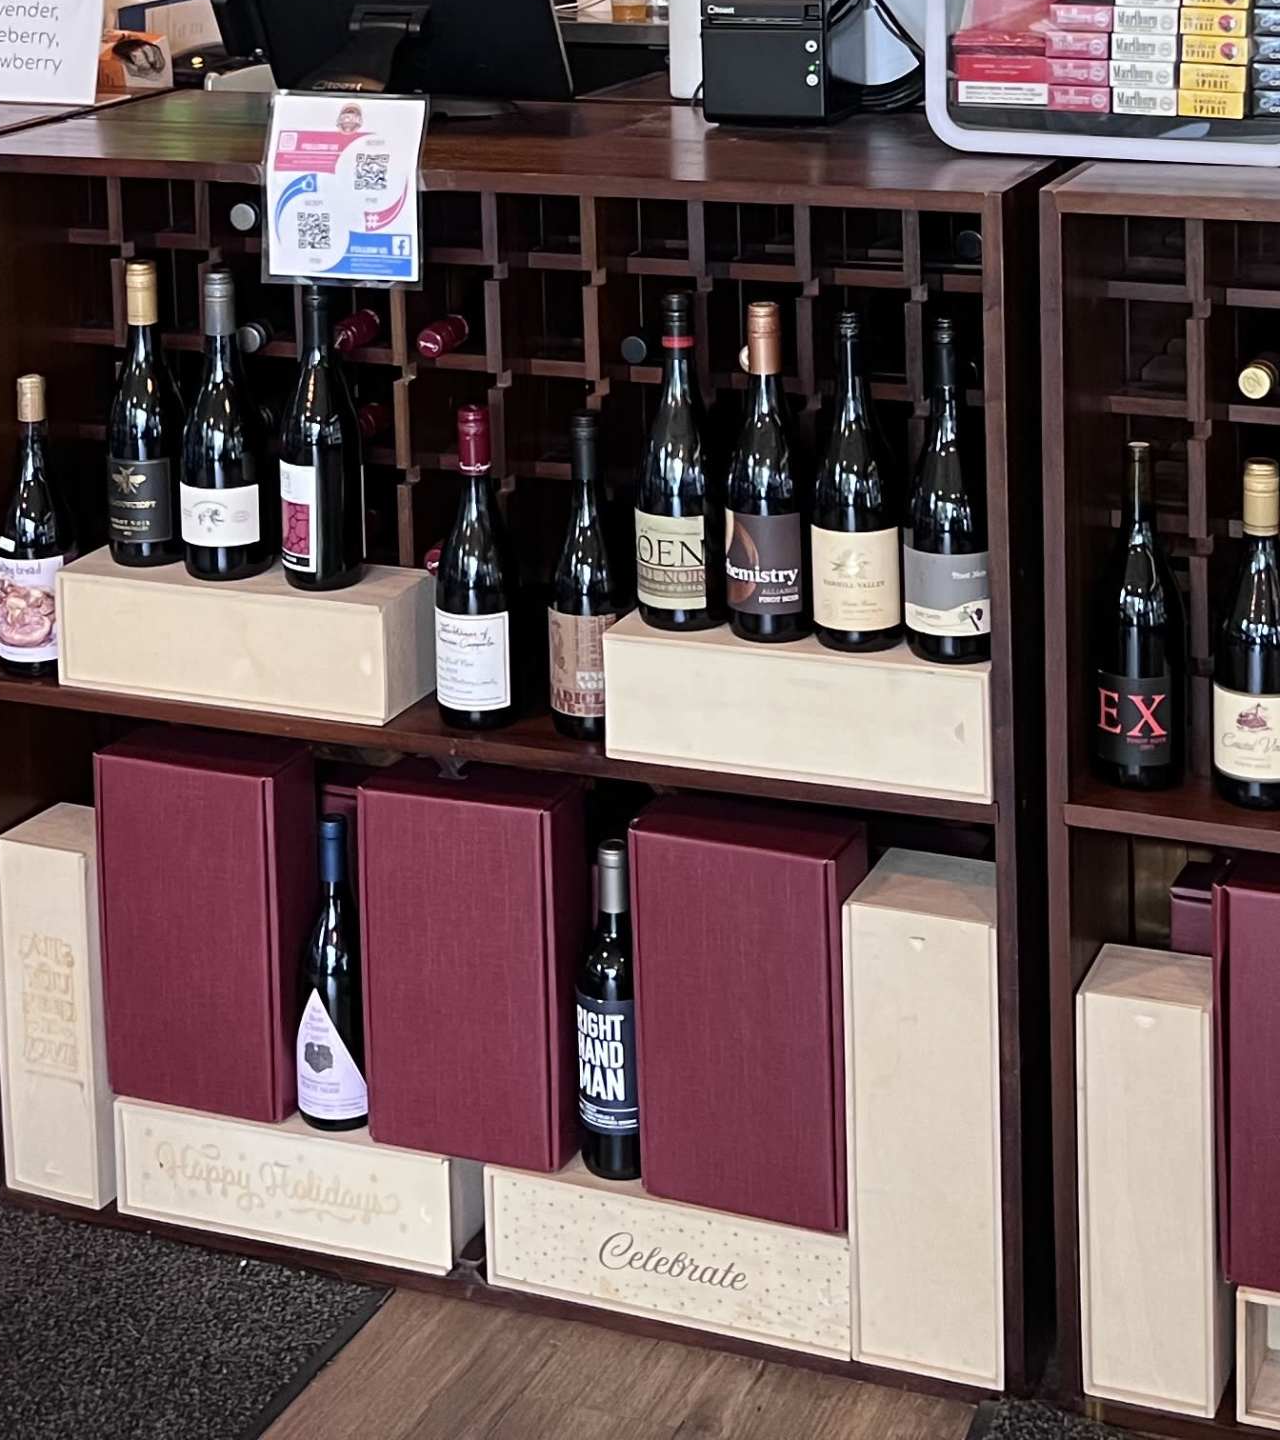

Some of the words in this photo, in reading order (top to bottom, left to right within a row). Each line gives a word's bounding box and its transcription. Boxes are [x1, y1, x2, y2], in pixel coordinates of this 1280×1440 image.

[1115, 37, 1156, 53] Marlboro
[1116, 91, 1157, 107] Marlboro
[638, 529, 705, 568] ÖEN
[1097, 687, 1168, 737] EX
[576, 1003, 625, 1042] RIGHT
[577, 1039, 625, 1071] HAND
[580, 1067, 626, 1103] MAN
[599, 1230, 749, 1292] Celebrate
